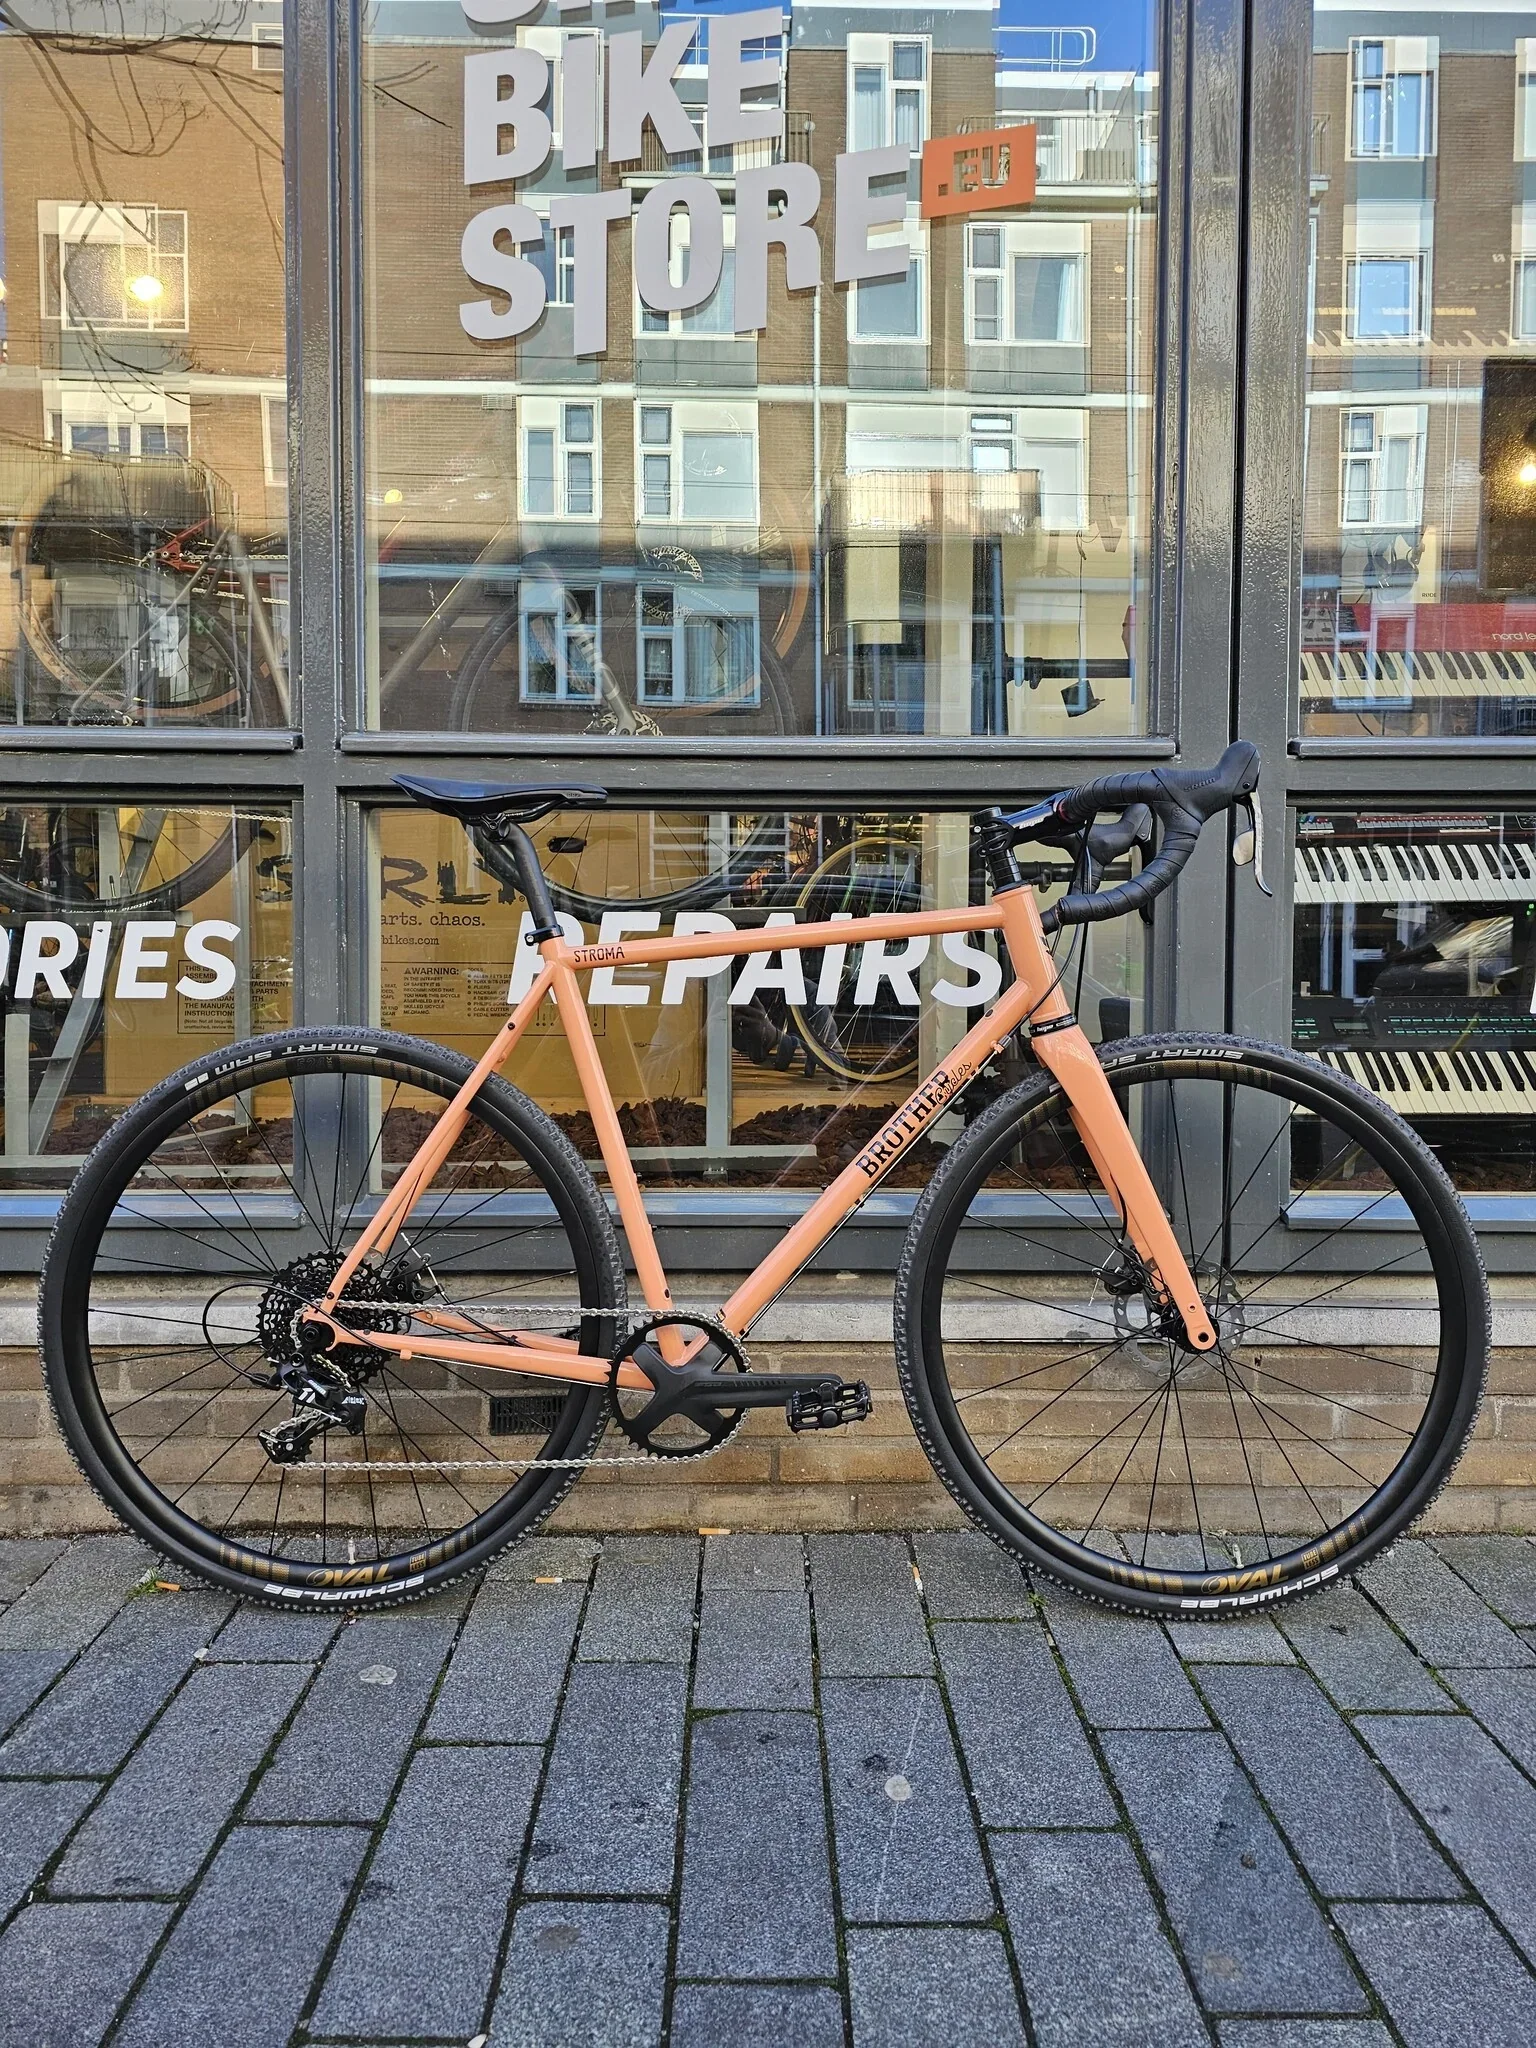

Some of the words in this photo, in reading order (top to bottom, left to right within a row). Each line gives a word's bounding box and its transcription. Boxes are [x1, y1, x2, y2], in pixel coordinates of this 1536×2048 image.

[464, 6, 784, 186] BIKE
[938, 143, 1010, 193] .EU
[459, 143, 910, 356] STORE
[1491, 631, 1523, 641] nord
[430, 912, 486, 926] chaos.
[0, 919, 241, 1000] RIES
[574, 947, 625, 962] STROMA
[215, 1050, 273, 1076] SAM
[281, 1043, 379, 1055] SMART
[1146, 1048, 1244, 1060] SMART
[934, 1061, 972, 1105] Cycles
[856, 1070, 951, 1178] BROTHER
[263, 1575, 425, 1601] SCHWALBE
[306, 1563, 394, 1587] OVAL
[1180, 1563, 1339, 1609] SCHWALBE
[1201, 1564, 1289, 1595] OVAL
